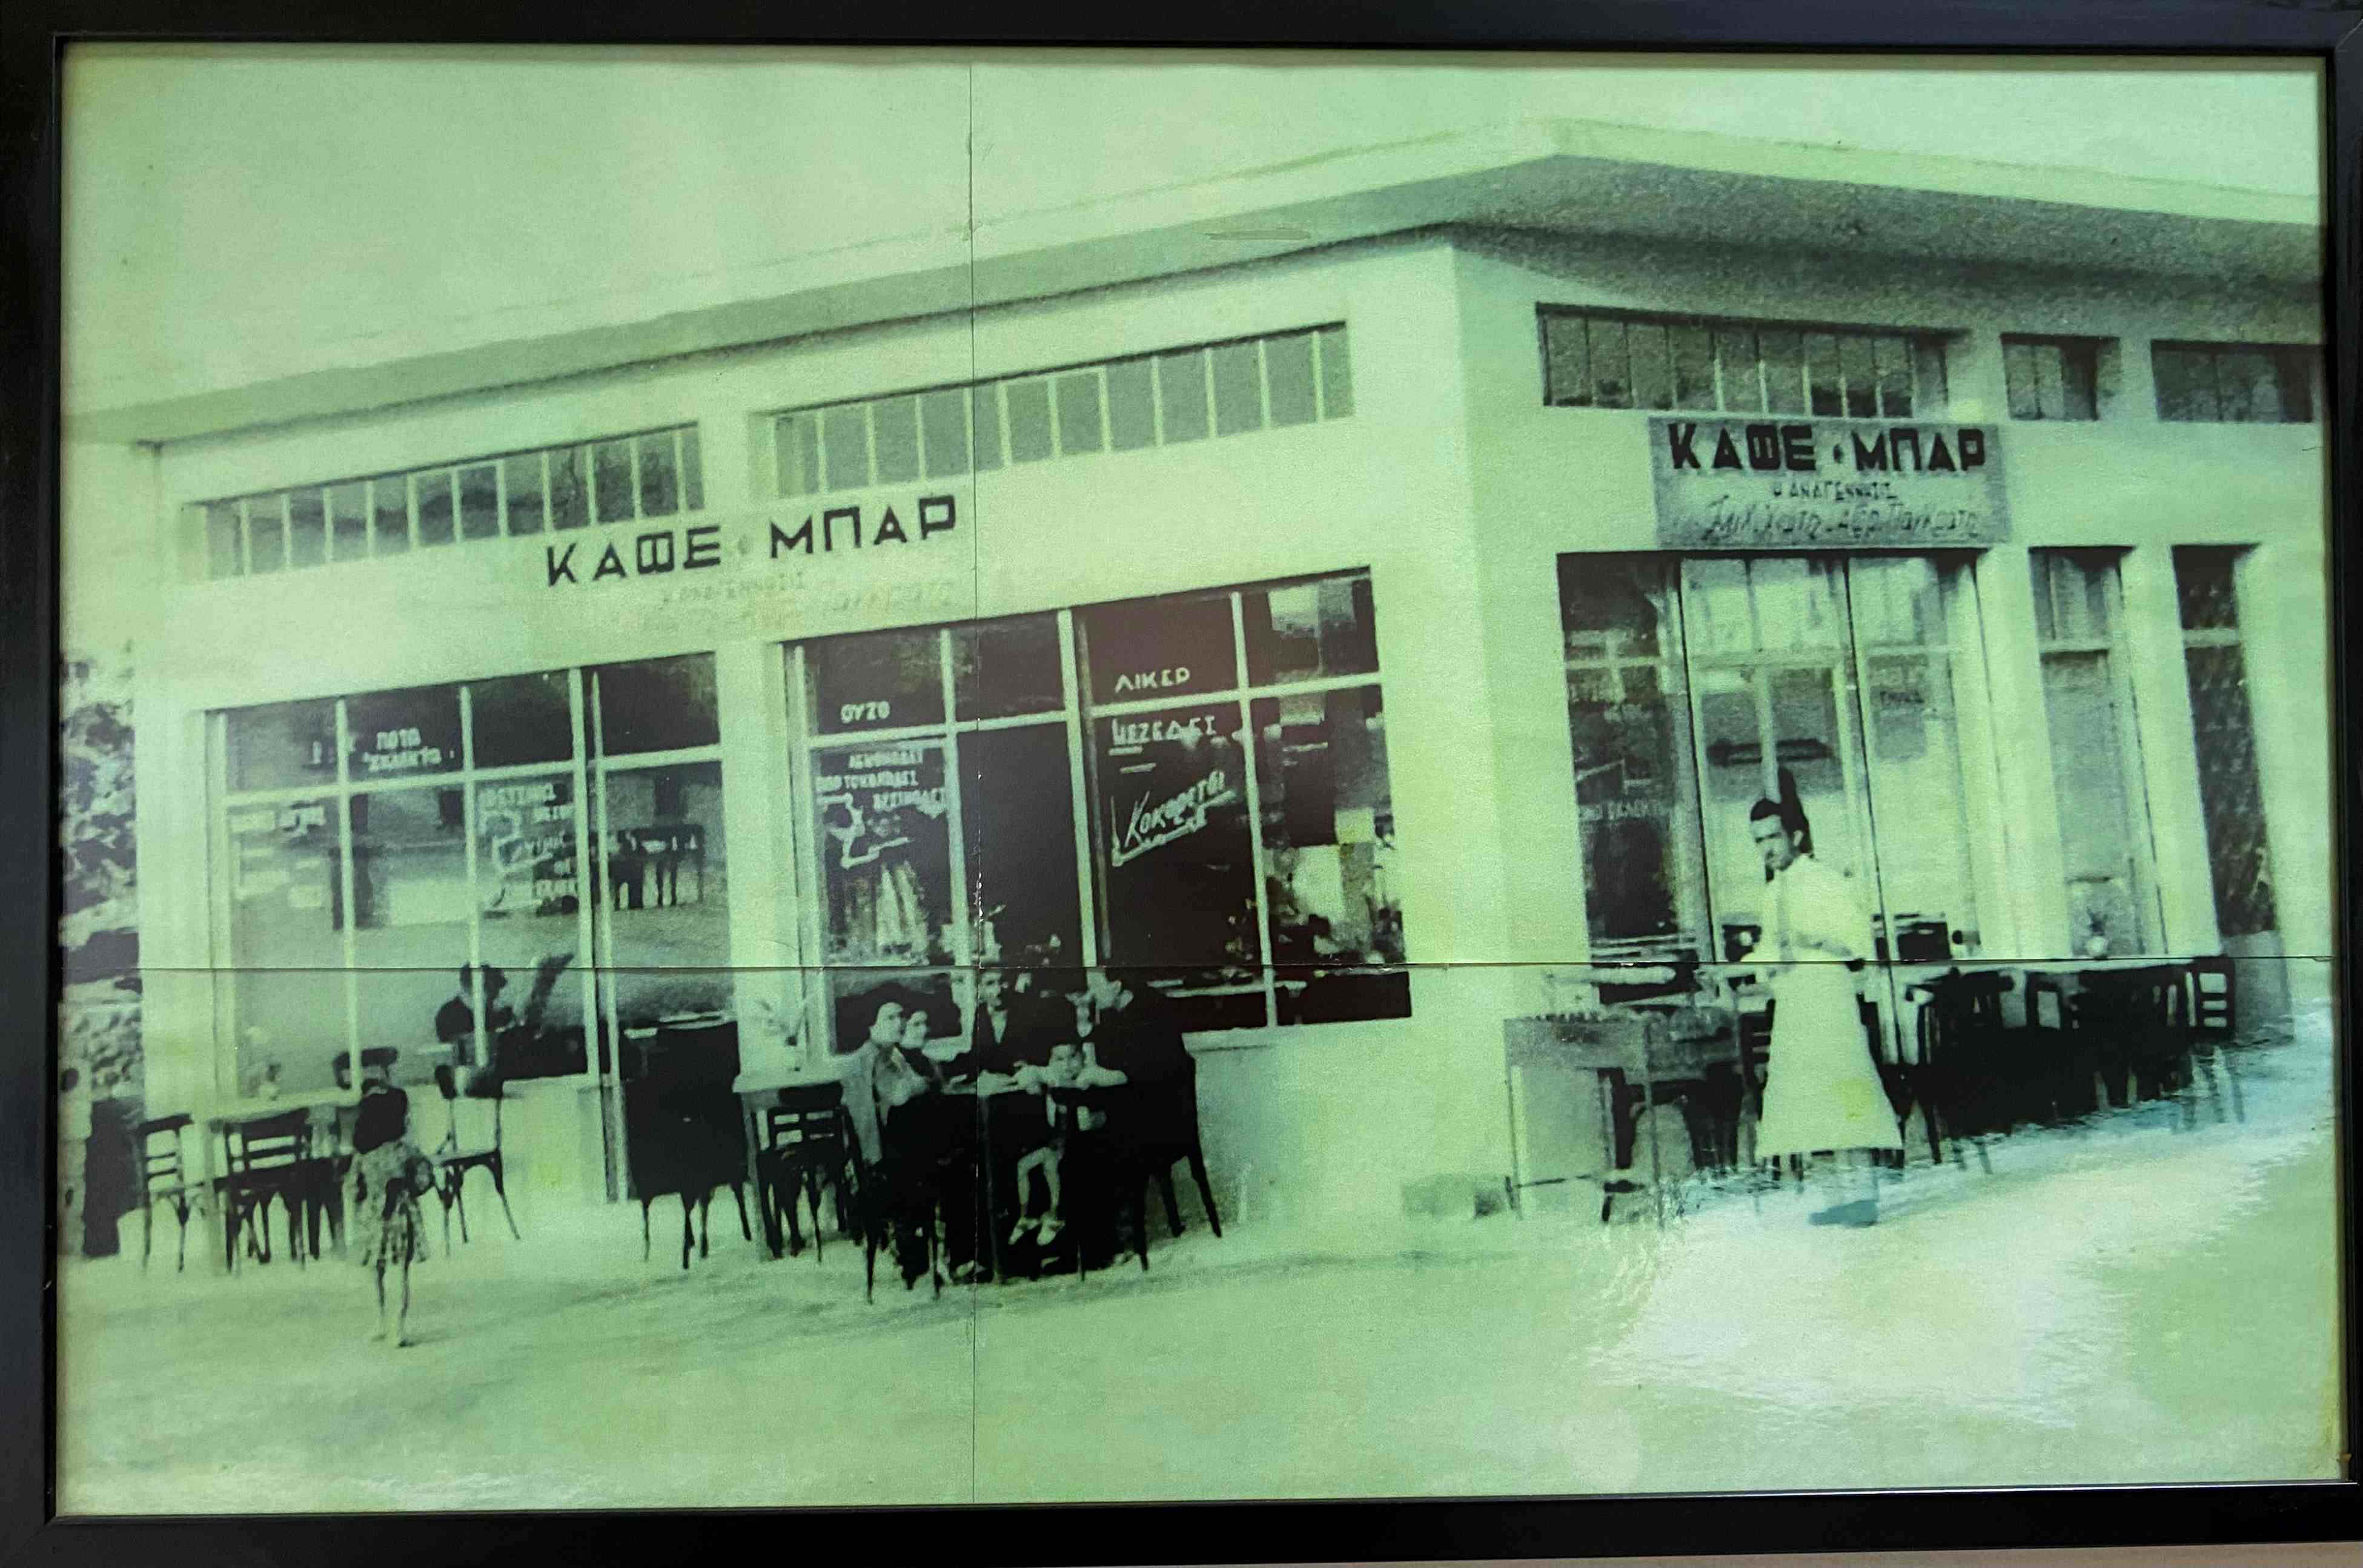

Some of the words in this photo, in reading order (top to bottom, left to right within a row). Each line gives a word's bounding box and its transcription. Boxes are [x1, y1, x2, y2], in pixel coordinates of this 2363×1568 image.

[1668, 423, 1817, 471] ΚΑΦΕ
[1852, 428, 1986, 472] ΜΠΑΡ
[546, 525, 721, 586] ΚΑΦΕ
[770, 495, 956, 558] ΜΠΑΡ
[1115, 667, 1191, 693] ΛΙΚΕΡ
